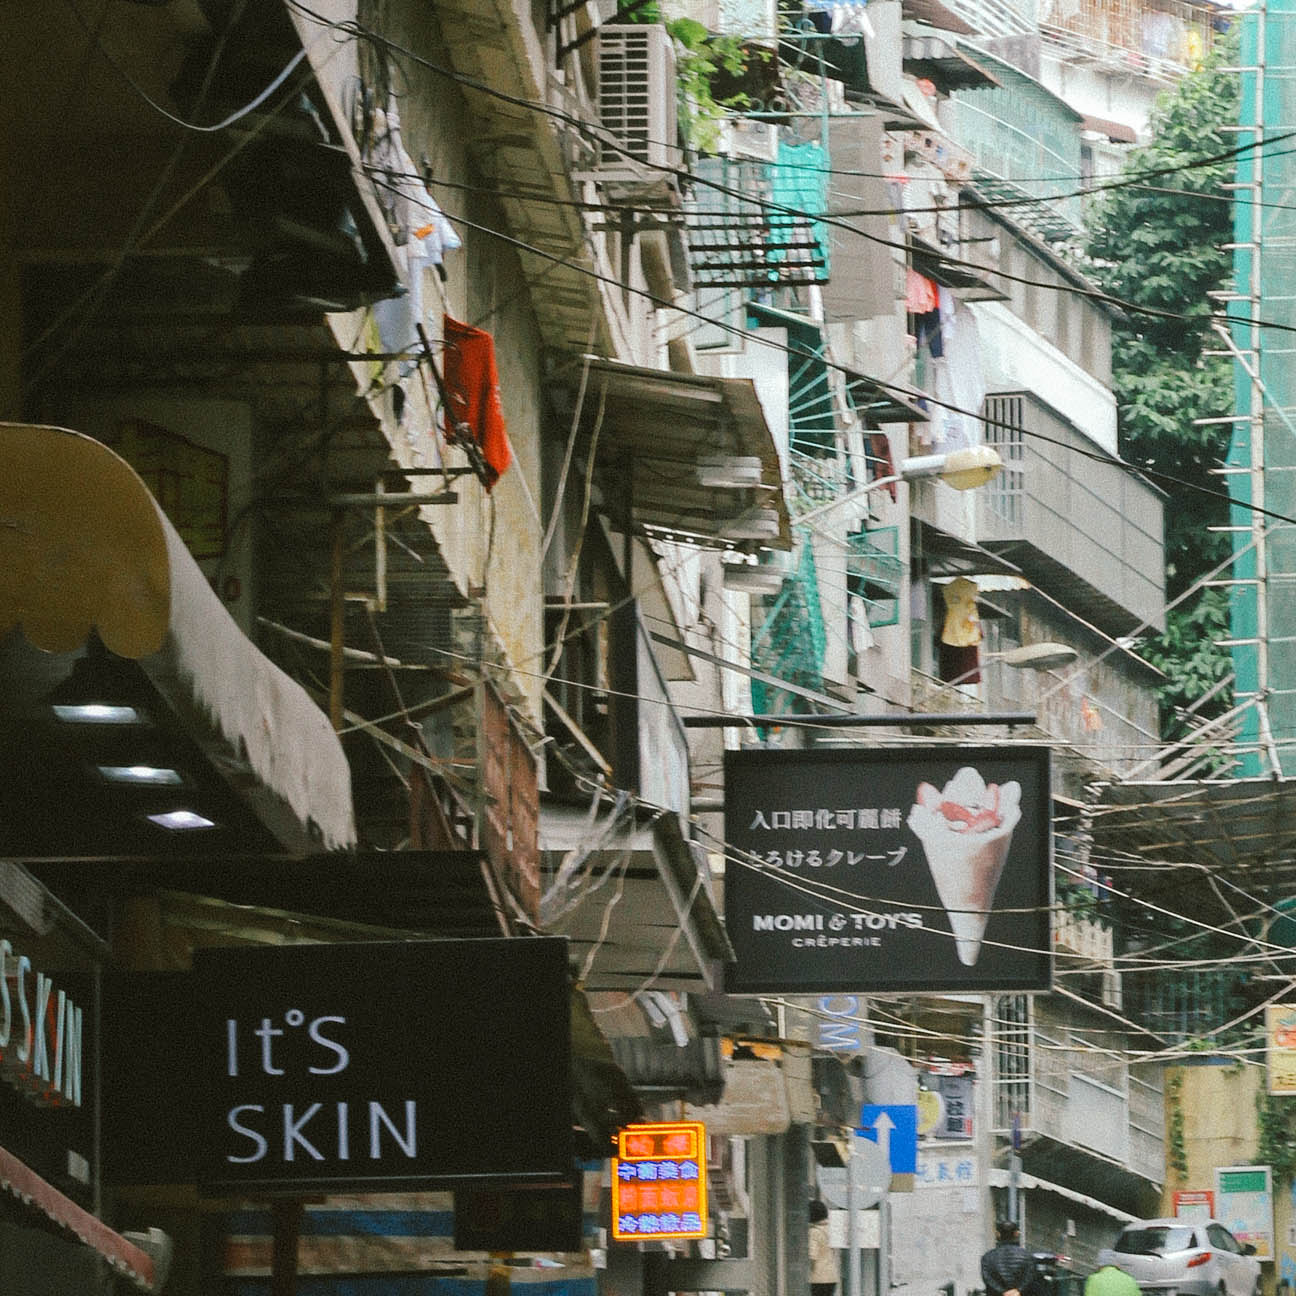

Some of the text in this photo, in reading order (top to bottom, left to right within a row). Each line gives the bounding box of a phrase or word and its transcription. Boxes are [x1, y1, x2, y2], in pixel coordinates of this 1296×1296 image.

[752, 911, 923, 932] MOMI & TOY'S
[791, 934, 882, 948] CRÊPERIE
[225, 1098, 418, 1164] SKIN
